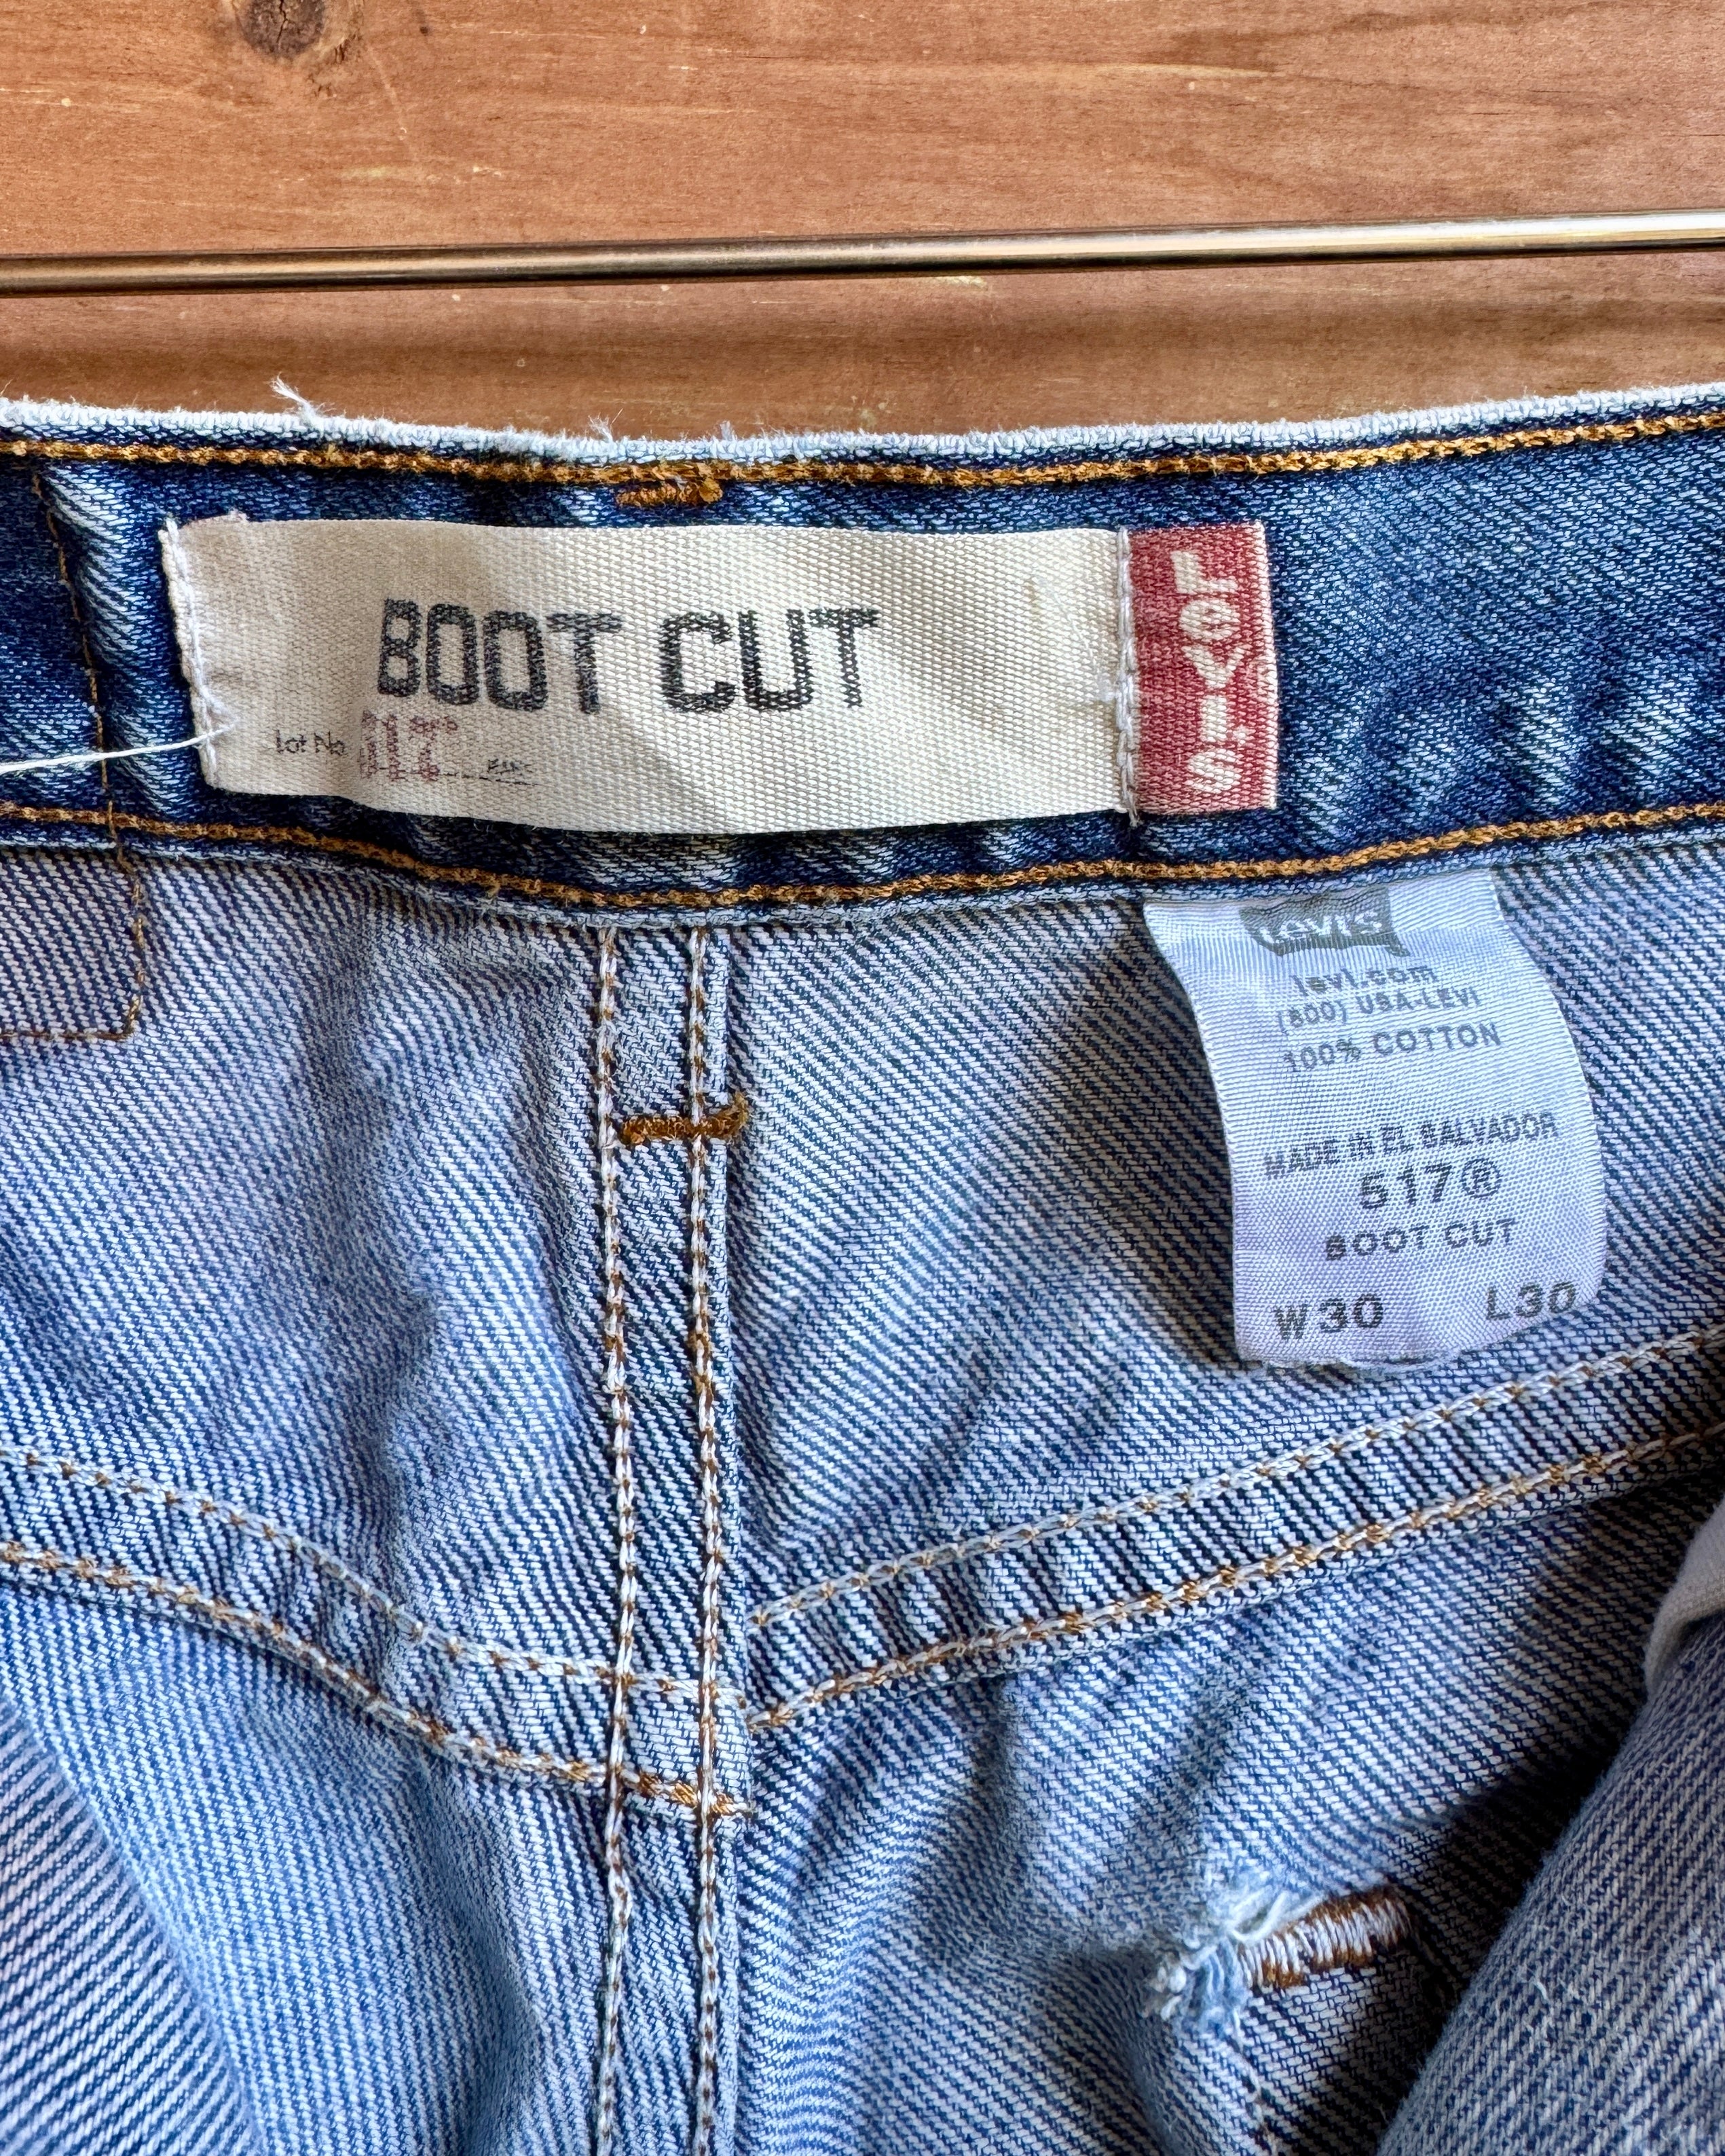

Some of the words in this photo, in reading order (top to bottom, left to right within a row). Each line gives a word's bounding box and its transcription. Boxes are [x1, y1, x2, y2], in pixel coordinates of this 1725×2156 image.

[377, 598, 624, 714] BOOT
[657, 608, 880, 713] CUT
[1284, 1037, 1360, 1073] 100%
[1371, 1021, 1502, 1056] COTTON
[1325, 1225, 1428, 1261] BOOT
[1443, 1219, 1516, 1249] CUT
[1273, 1293, 1384, 1341] W30
[1487, 1282, 1577, 1321] L30
